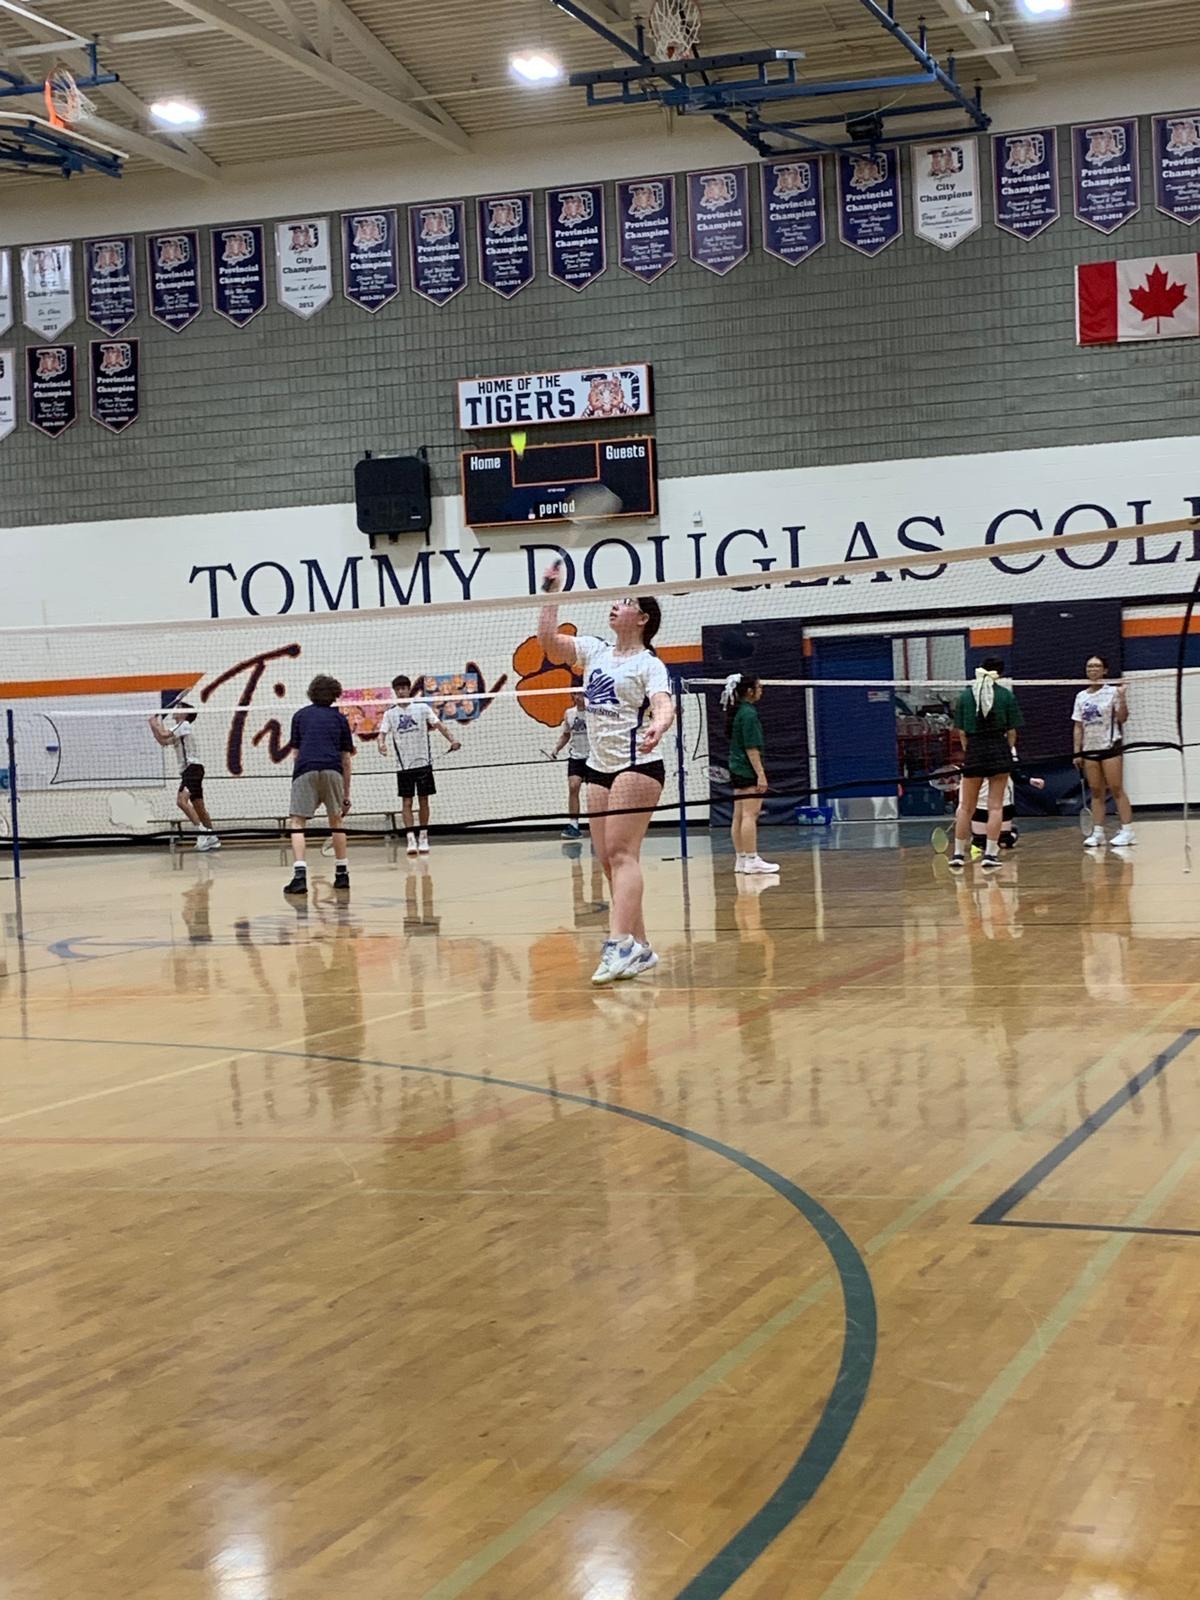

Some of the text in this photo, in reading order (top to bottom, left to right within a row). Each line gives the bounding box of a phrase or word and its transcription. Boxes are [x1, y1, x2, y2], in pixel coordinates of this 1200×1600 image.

[1081, 164, 1131, 177] Provincial
[1001, 171, 1050, 184] Provincial
[1081, 175, 1132, 188] Champion
[936, 182, 956, 192] City
[1001, 183, 1050, 196] Champion
[846, 189, 893, 202] Provincial
[920, 190, 973, 203] Champions
[770, 198, 816, 211] Provincial
[846, 200, 894, 212] Champion
[696, 209, 742, 221] Provincial
[770, 210, 816, 222] Champion
[624, 218, 668, 230] Provincial
[697, 220, 743, 232] Champion
[555, 226, 598, 238] Provincial
[624, 229, 670, 240] Champion
[938, 230, 957, 240] 2017
[486, 234, 528, 246] Provincial
[556, 238, 598, 248] Champion
[417, 242, 460, 252] Provincial
[486, 245, 528, 256] Champion
[296, 256, 312, 265] City
[350, 250, 392, 260] Provincial
[418, 253, 460, 263] Champion
[219, 264, 259, 274] Provincial
[282, 265, 326, 275] Champions
[350, 261, 392, 271] Champion
[92, 275, 130, 286] Provincial
[155, 270, 194, 280] Provincial
[220, 275, 260, 285] Champion
[92, 285, 130, 295] Champion
[156, 280, 195, 290] Champion
[34, 379, 71, 389] Provincial
[97, 375, 135, 384] Provincial
[478, 375, 560, 395] HOME OF THE
[34, 388, 72, 398] Champion
[97, 384, 136, 394] Champion
[465, 388, 576, 426] TIGERS
[606, 445, 645, 460] Guests
[470, 456, 500, 471] Home
[540, 500, 576, 518] period
[189, 496, 1200, 618] TOMMY DOUGLAS COL
